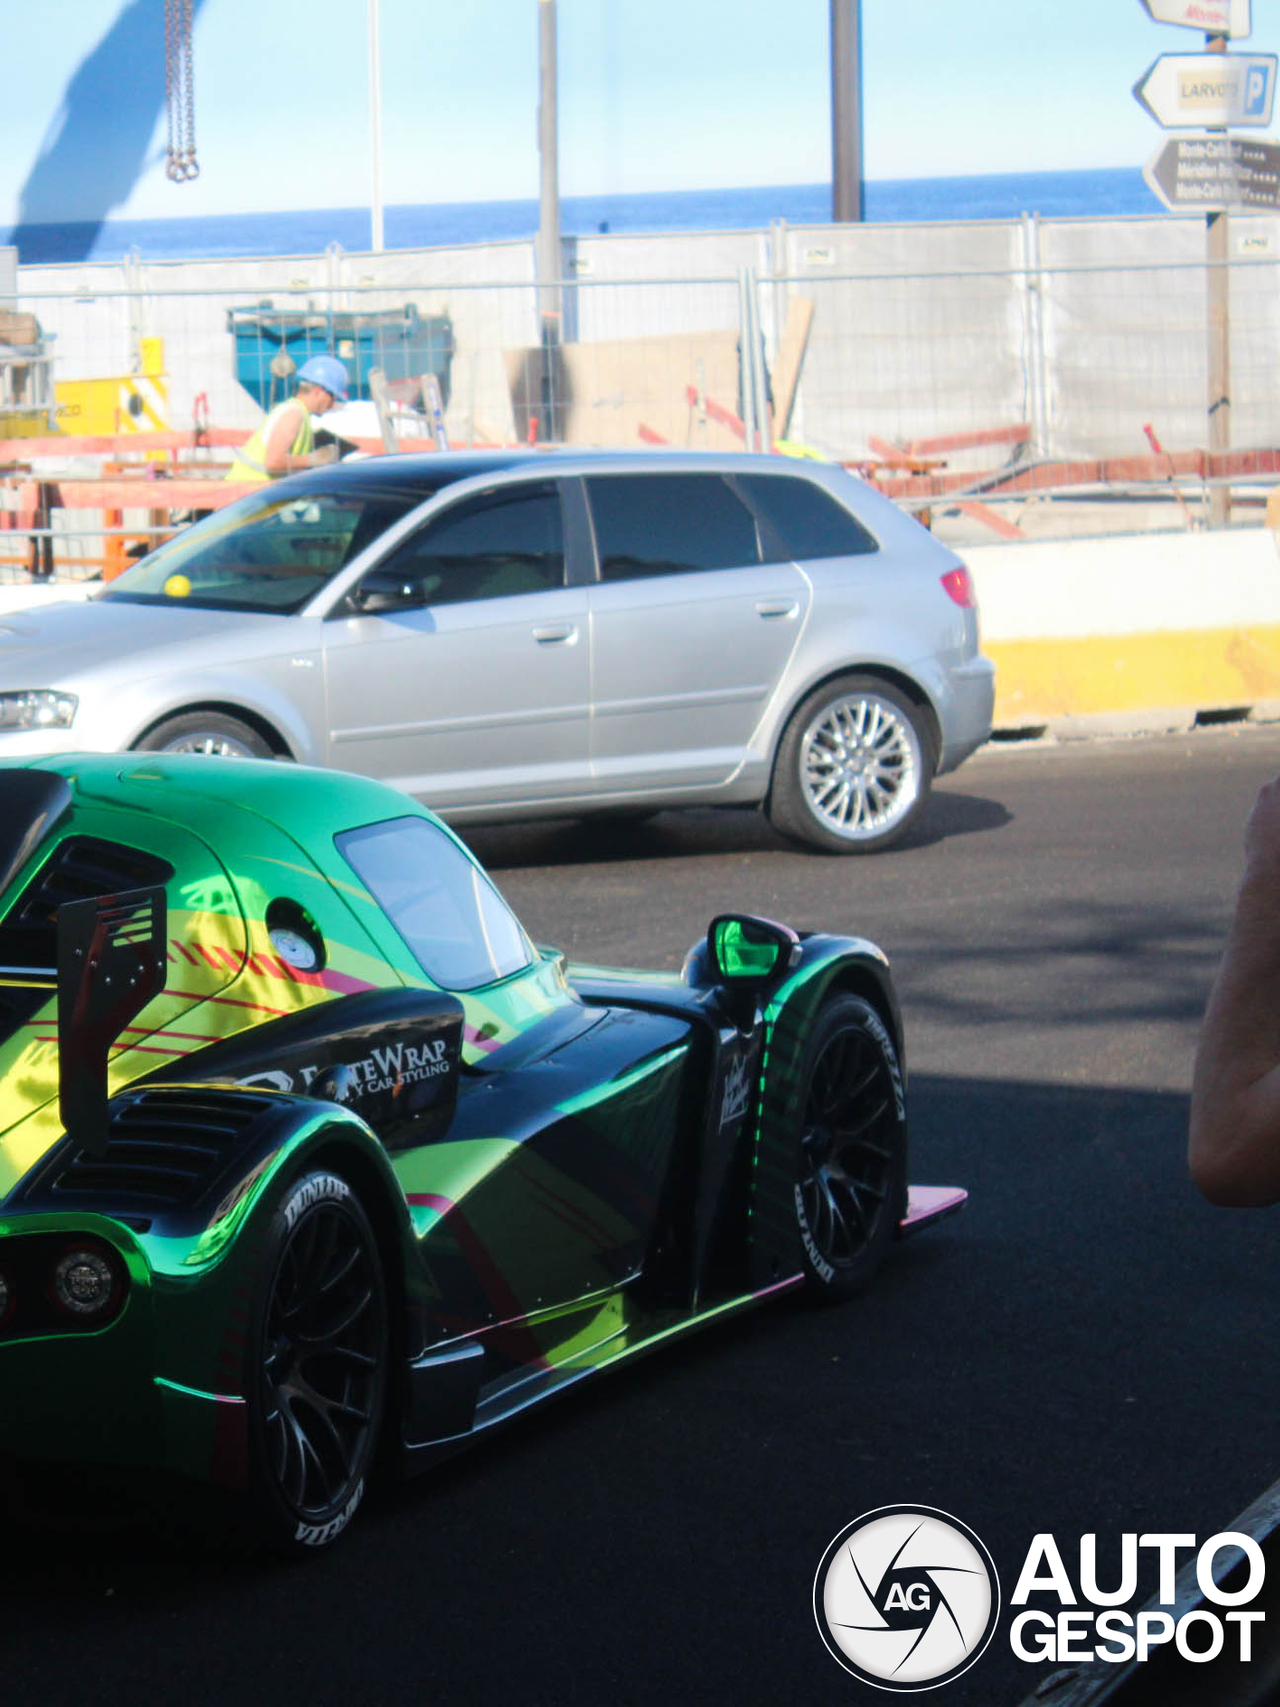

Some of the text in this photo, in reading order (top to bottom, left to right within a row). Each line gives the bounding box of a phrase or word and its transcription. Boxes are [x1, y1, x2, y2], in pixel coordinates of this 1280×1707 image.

[368, 1076, 395, 1093] CAR
[397, 1060, 450, 1086] STYLING
[284, 1175, 349, 1231] DUNLOP
